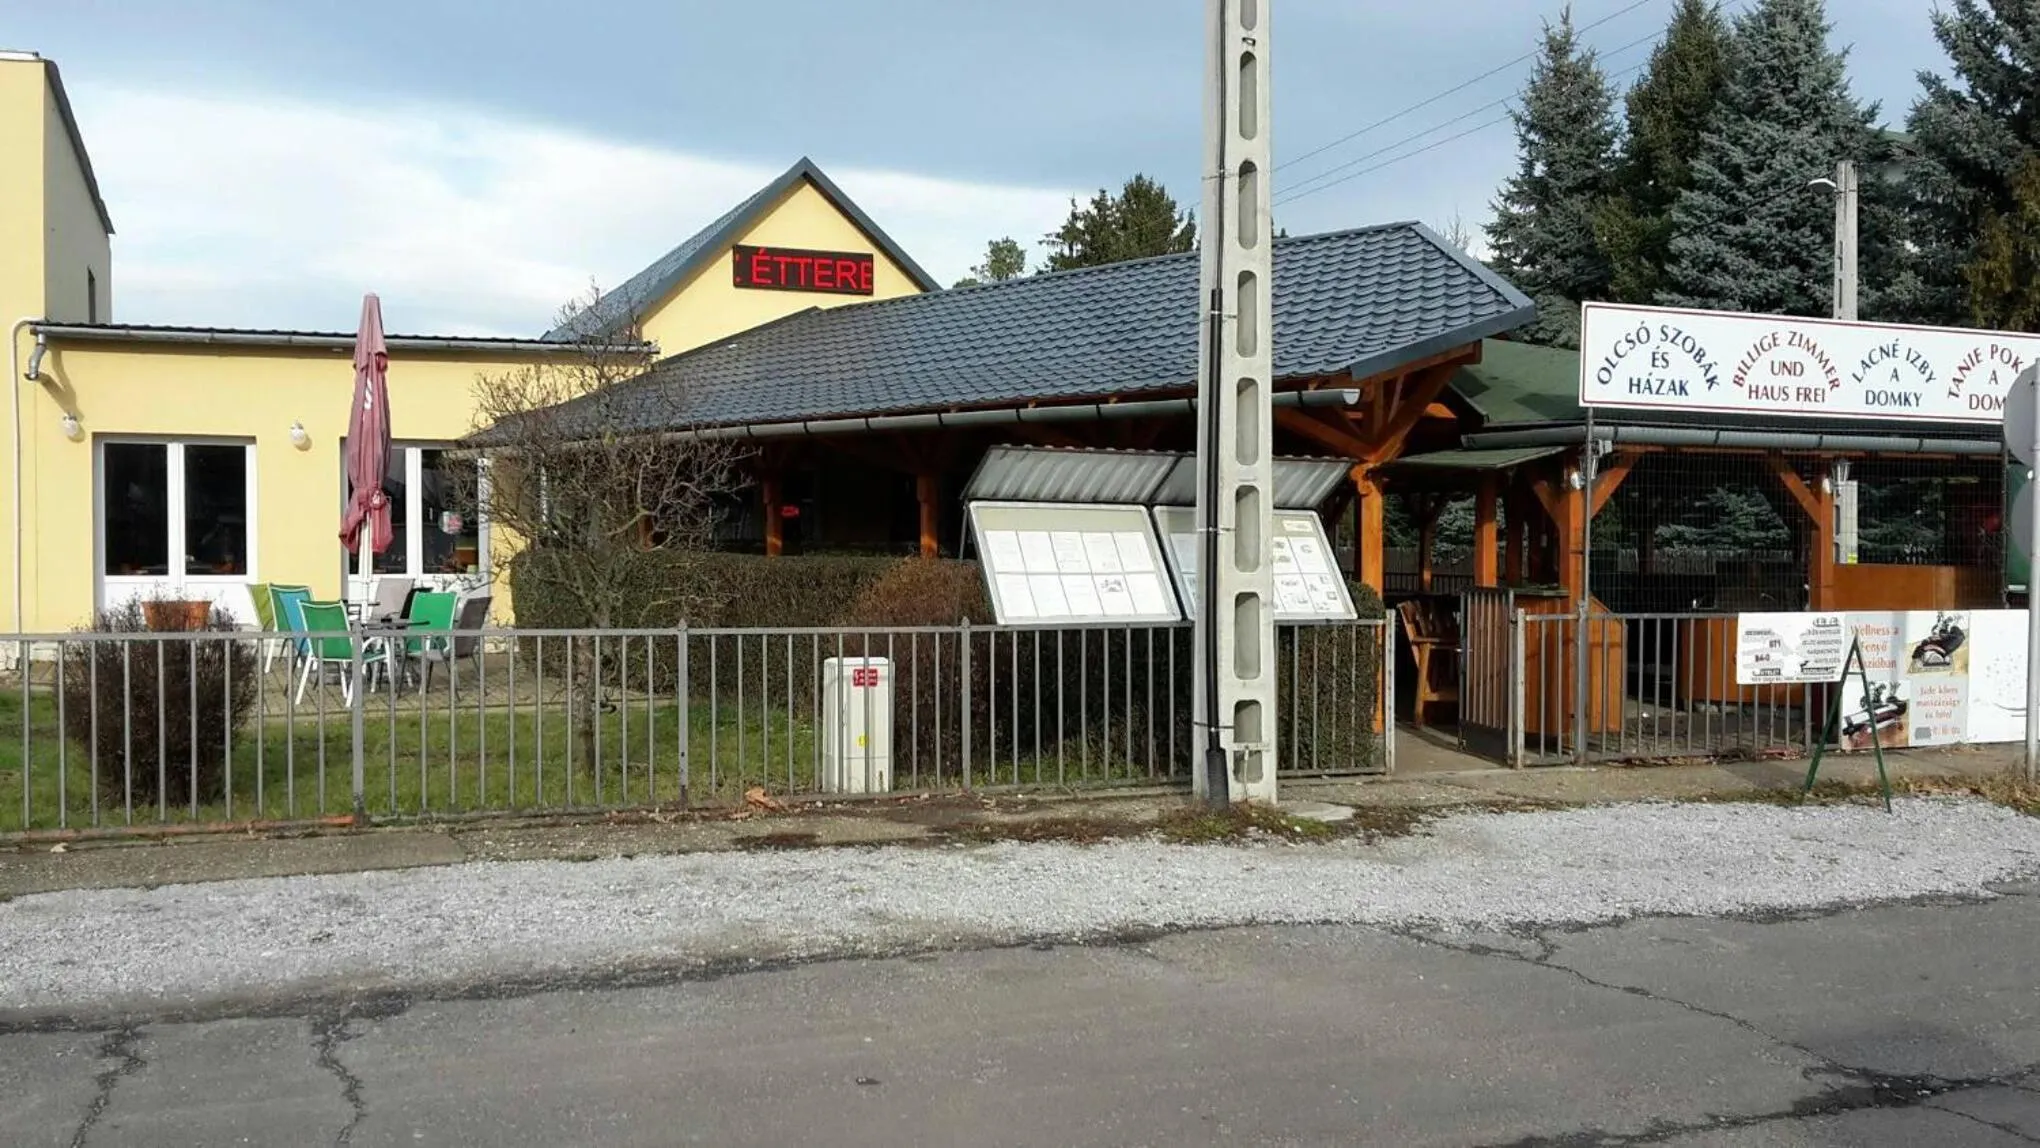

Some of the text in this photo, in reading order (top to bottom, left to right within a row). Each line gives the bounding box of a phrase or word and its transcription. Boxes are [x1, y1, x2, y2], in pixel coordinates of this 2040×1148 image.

[1597, 321, 1720, 392] OLCSÓ SZOBÁK
[1651, 345, 1670, 369] ÉS
[1732, 330, 1841, 393] BILLIGE ZIMMER
[1852, 338, 1937, 384] LACNÉ IZBY
[1770, 359, 1805, 377] UND
[1889, 367, 1900, 383] A
[1947, 343, 2024, 400] TANIE POK
[1988, 369, 1999, 386] A
[1628, 372, 1689, 397] HÁZAK
[1748, 383, 1826, 403] HAUS FREI
[1864, 389, 1923, 408] DOMKY
[1968, 393, 2007, 412] DOM
